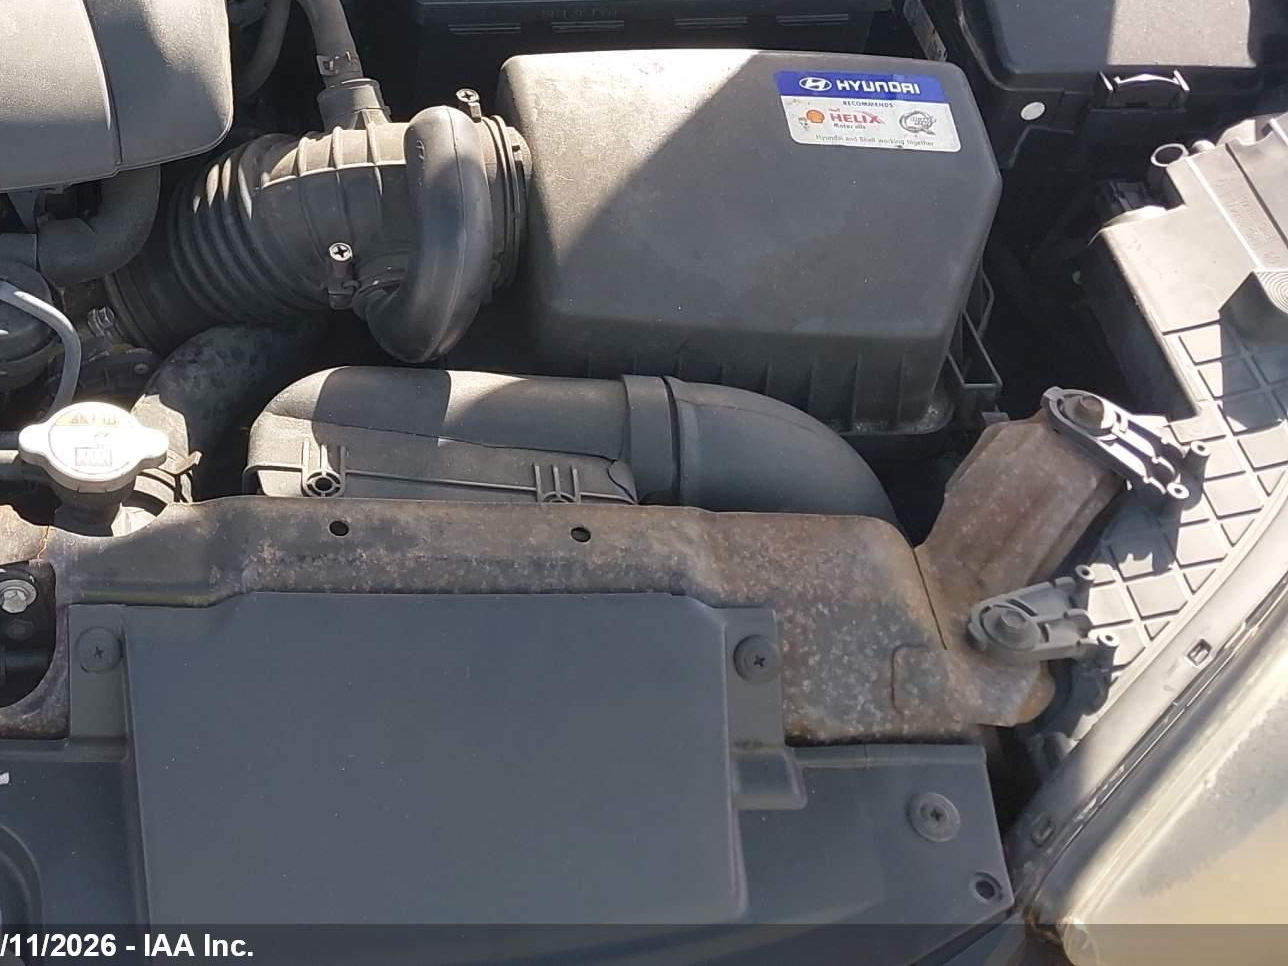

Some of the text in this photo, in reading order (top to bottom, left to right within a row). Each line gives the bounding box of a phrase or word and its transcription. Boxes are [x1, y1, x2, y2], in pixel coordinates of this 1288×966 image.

[836, 79, 920, 95] HYUNDAI
[842, 100, 894, 108] RECOMMENDS
[829, 113, 881, 124] HELIX
